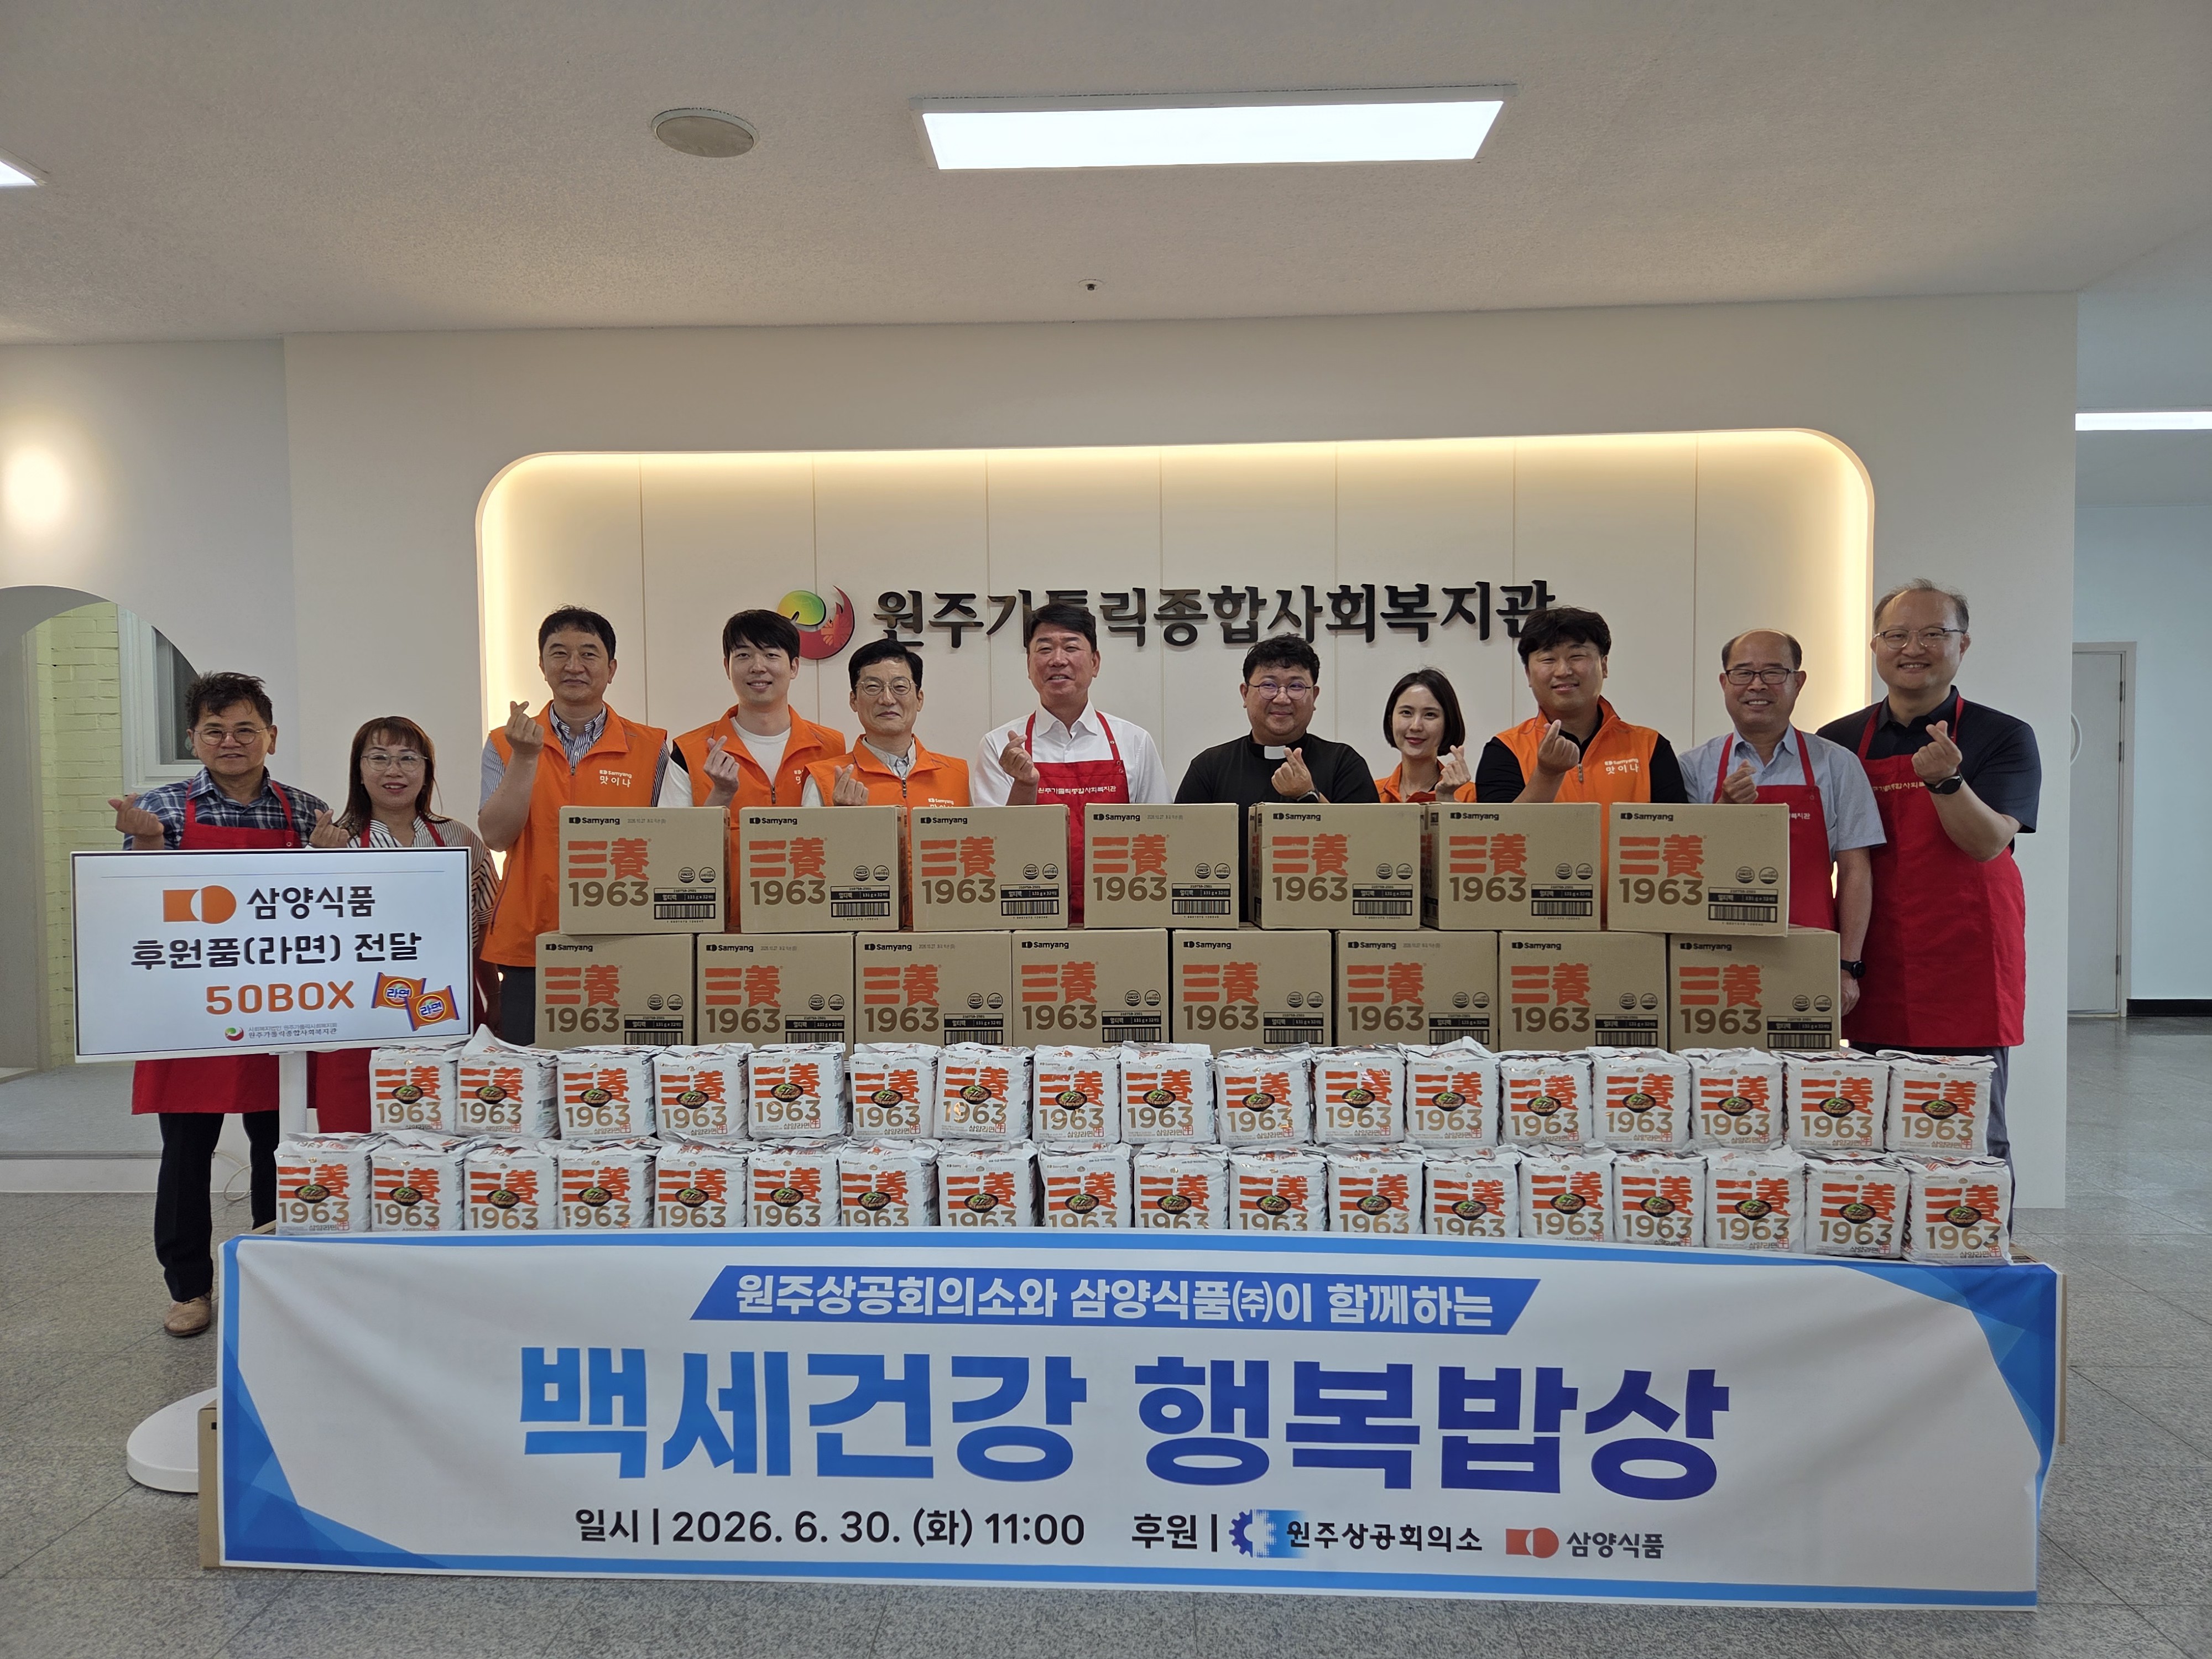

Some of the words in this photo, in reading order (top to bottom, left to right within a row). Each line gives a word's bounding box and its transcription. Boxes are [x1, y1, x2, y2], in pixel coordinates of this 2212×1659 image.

[608, 770, 632, 779] Samyang
[582, 816, 620, 826] Samyang
[761, 817, 797, 826] Samyang
[932, 816, 967, 825] Samyang
[1105, 813, 1140, 822] Samyang
[1285, 813, 1321, 821] Samyang
[1462, 812, 1499, 821] Samyang
[1634, 813, 1673, 821] Samyang
[567, 837, 650, 881] 三養
[749, 837, 827, 880] 三養
[921, 836, 996, 878] 三養
[1092, 833, 1167, 876] 三養
[1272, 833, 1349, 875] 三養
[1449, 833, 1527, 875] 三養
[1619, 834, 1704, 879] 三養
[568, 881, 649, 907] 1963
[750, 880, 826, 905] 1963
[921, 879, 995, 904] 1963
[1093, 877, 1167, 901] 1963
[1272, 877, 1348, 901] 1963
[1449, 877, 1526, 902] 1963
[1619, 878, 1703, 906] 1963
[247, 886, 375, 920] 삼양식품
[131, 935, 341, 970] 후원품(라면)
[354, 932, 421, 963] 전달
[558, 943, 593, 952] Samyang
[718, 944, 753, 952] Samyang
[877, 943, 912, 951] Samyang
[1033, 941, 1068, 950] Samyang
[1196, 941, 1231, 950] Samyang
[1360, 941, 1396, 950] Samyang
[1524, 942, 1561, 951] Samyang
[1693, 942, 1731, 951] Samyang
[544, 964, 620, 1008] 三養
[705, 965, 781, 1008] 三養
[863, 964, 940, 1006] 三養
[1021, 961, 1097, 1004] 三養
[1183, 962, 1259, 1005] 三養
[1347, 962, 1425, 1006] 三養
[1511, 963, 1591, 1006] 三養
[1679, 964, 1762, 1008] 三養
[206, 980, 354, 1015] 50BOX
[419, 1001, 442, 1016] 라면
[545, 1008, 619, 1033] 1963
[706, 1008, 780, 1033] 1963
[864, 1008, 939, 1032] 1963
[1022, 1005, 1097, 1030] 1963
[1183, 1005, 1259, 1030] 1963
[1348, 1006, 1424, 1031] 1963
[1512, 1007, 1590, 1032] 1963
[1680, 1008, 1762, 1035] 1963
[376, 1102, 441, 1125] 1963
[460, 1103, 521, 1124] 1963
[565, 1105, 630, 1128] 1963
[662, 1105, 727, 1129] 1963
[754, 1100, 821, 1122] 1963
[855, 1104, 920, 1127] 1963
[943, 1101, 1006, 1124] 1963
[1039, 1108, 1104, 1130] 1963
[1128, 1106, 1193, 1129] 1963
[1227, 1109, 1292, 1132] 1963
[1325, 1107, 1391, 1128] 1963
[1415, 1109, 1482, 1131] 1963
[1605, 1111, 1672, 1133] 1963
[1510, 1113, 1578, 1136] 1963
[1701, 1114, 1769, 1136] 1963
[1801, 1116, 1872, 1138] 1963
[1902, 1116, 1975, 1139] 1963
[279, 1202, 349, 1223] 1963
[374, 1203, 441, 1226] 1963
[471, 1207, 538, 1230] 1963
[562, 1204, 630, 1228] 1963
[659, 1205, 727, 1227] 1963
[753, 1206, 820, 1226] 1963
[1532, 1212, 1604, 1234] 1963
[1622, 1217, 1692, 1238] 1963
[1717, 1218, 1790, 1241] 1963
[1819, 1221, 1891, 1246] 1963
[1926, 1226, 1999, 1250] 1963
[736, 1274, 1057, 1317] 원주상공회의소와
[1328, 1282, 1493, 1327] 함께하는
[520, 1346, 1087, 1482] 백세건강
[1135, 1356, 1729, 1500] 행복밥상
[575, 1508, 640, 1543] 일시
[912, 1507, 973, 1548] (화)
[984, 1512, 1085, 1545] 11:00
[1132, 1513, 1198, 1550] 후원
[1287, 1520, 1482, 1552] 원주상공회의소
[1566, 1532, 1665, 1559] 삼양식품
